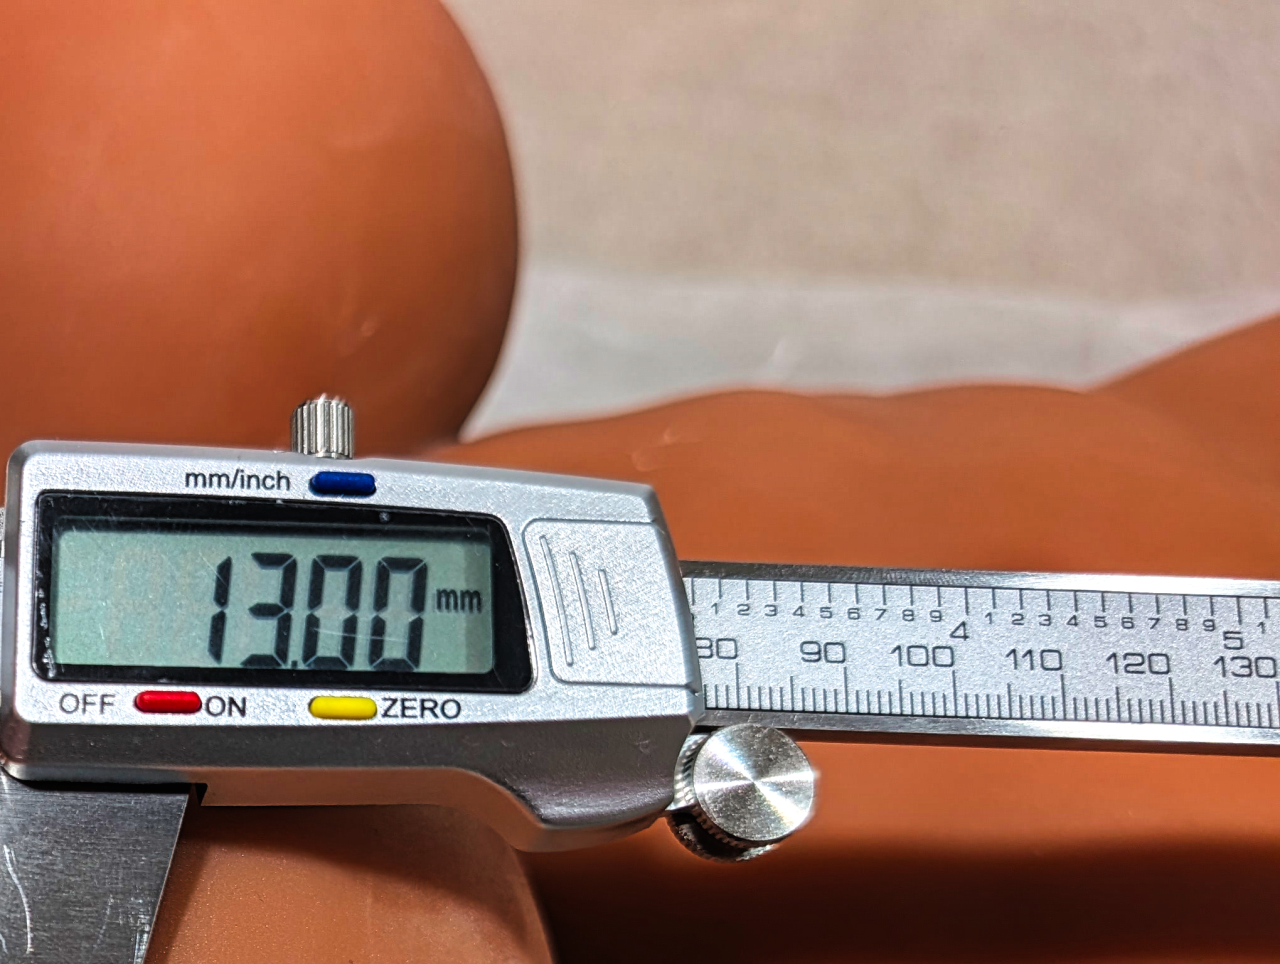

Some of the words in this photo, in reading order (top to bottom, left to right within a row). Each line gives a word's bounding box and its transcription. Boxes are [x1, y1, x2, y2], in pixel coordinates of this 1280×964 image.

[184, 468, 291, 491] mm/inch
[207, 552, 428, 672] 13.00
[434, 588, 483, 613] mm
[710, 602, 719, 615] 1
[736, 603, 751, 616] 2
[764, 604, 778, 617] 3
[792, 605, 805, 618] 4
[819, 606, 833, 619] 5
[847, 607, 861, 620] 6
[874, 608, 887, 621] 7
[901, 609, 915, 622] 8
[928, 609, 942, 622] 9
[949, 621, 970, 641] 4
[984, 612, 993, 625] 1
[1011, 613, 1025, 626] 2
[1038, 613, 1052, 627] 3
[1065, 614, 1079, 627] 4
[1094, 615, 1108, 628] 5
[1121, 616, 1135, 630] 6
[1147, 617, 1161, 630] 7
[1175, 618, 1189, 631] 8
[1202, 619, 1216, 632] 9
[1223, 630, 1244, 651] 5
[1257, 621, 1266, 634] 1
[799, 640, 846, 664] 90
[889, 644, 955, 668] 100
[1006, 648, 1064, 671] 110
[1105, 651, 1171, 675] 120
[1213, 655, 1278, 679] 130
[58, 692, 116, 716] OFF
[204, 695, 247, 717] ON
[380, 697, 463, 720] ZERO
